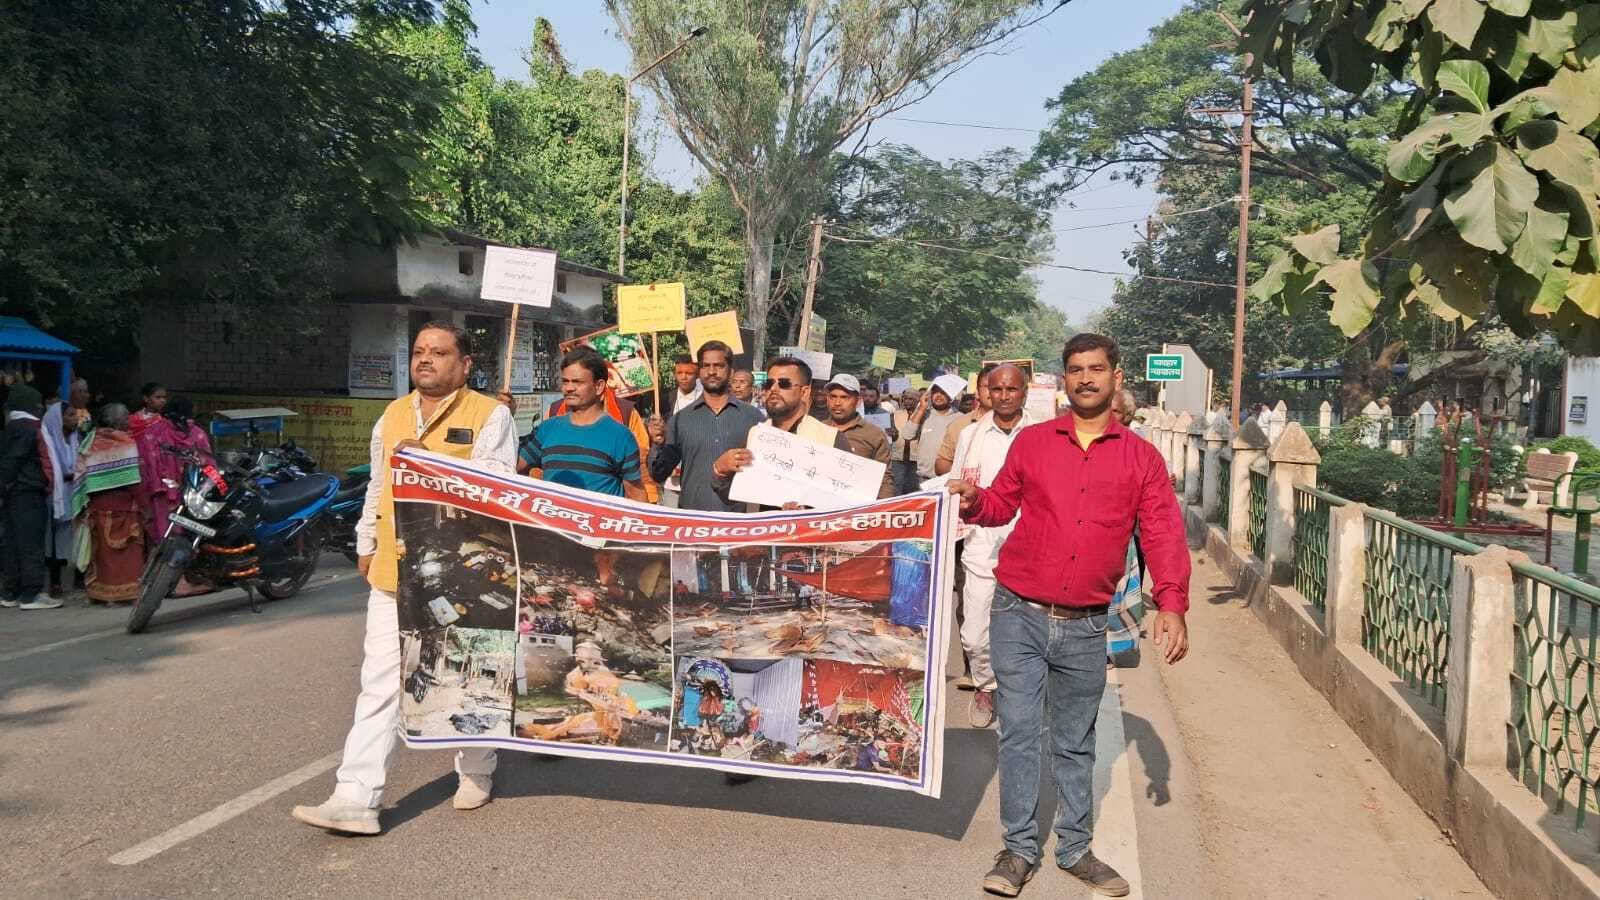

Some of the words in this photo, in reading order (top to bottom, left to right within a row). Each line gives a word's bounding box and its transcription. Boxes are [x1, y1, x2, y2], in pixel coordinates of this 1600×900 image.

[498, 490, 529, 509] में
[531, 497, 594, 533] हिन्दू
[600, 516, 670, 536] मंदिर
[674, 523, 797, 539] (ISKCON)
[851, 511, 927, 531] हमला
